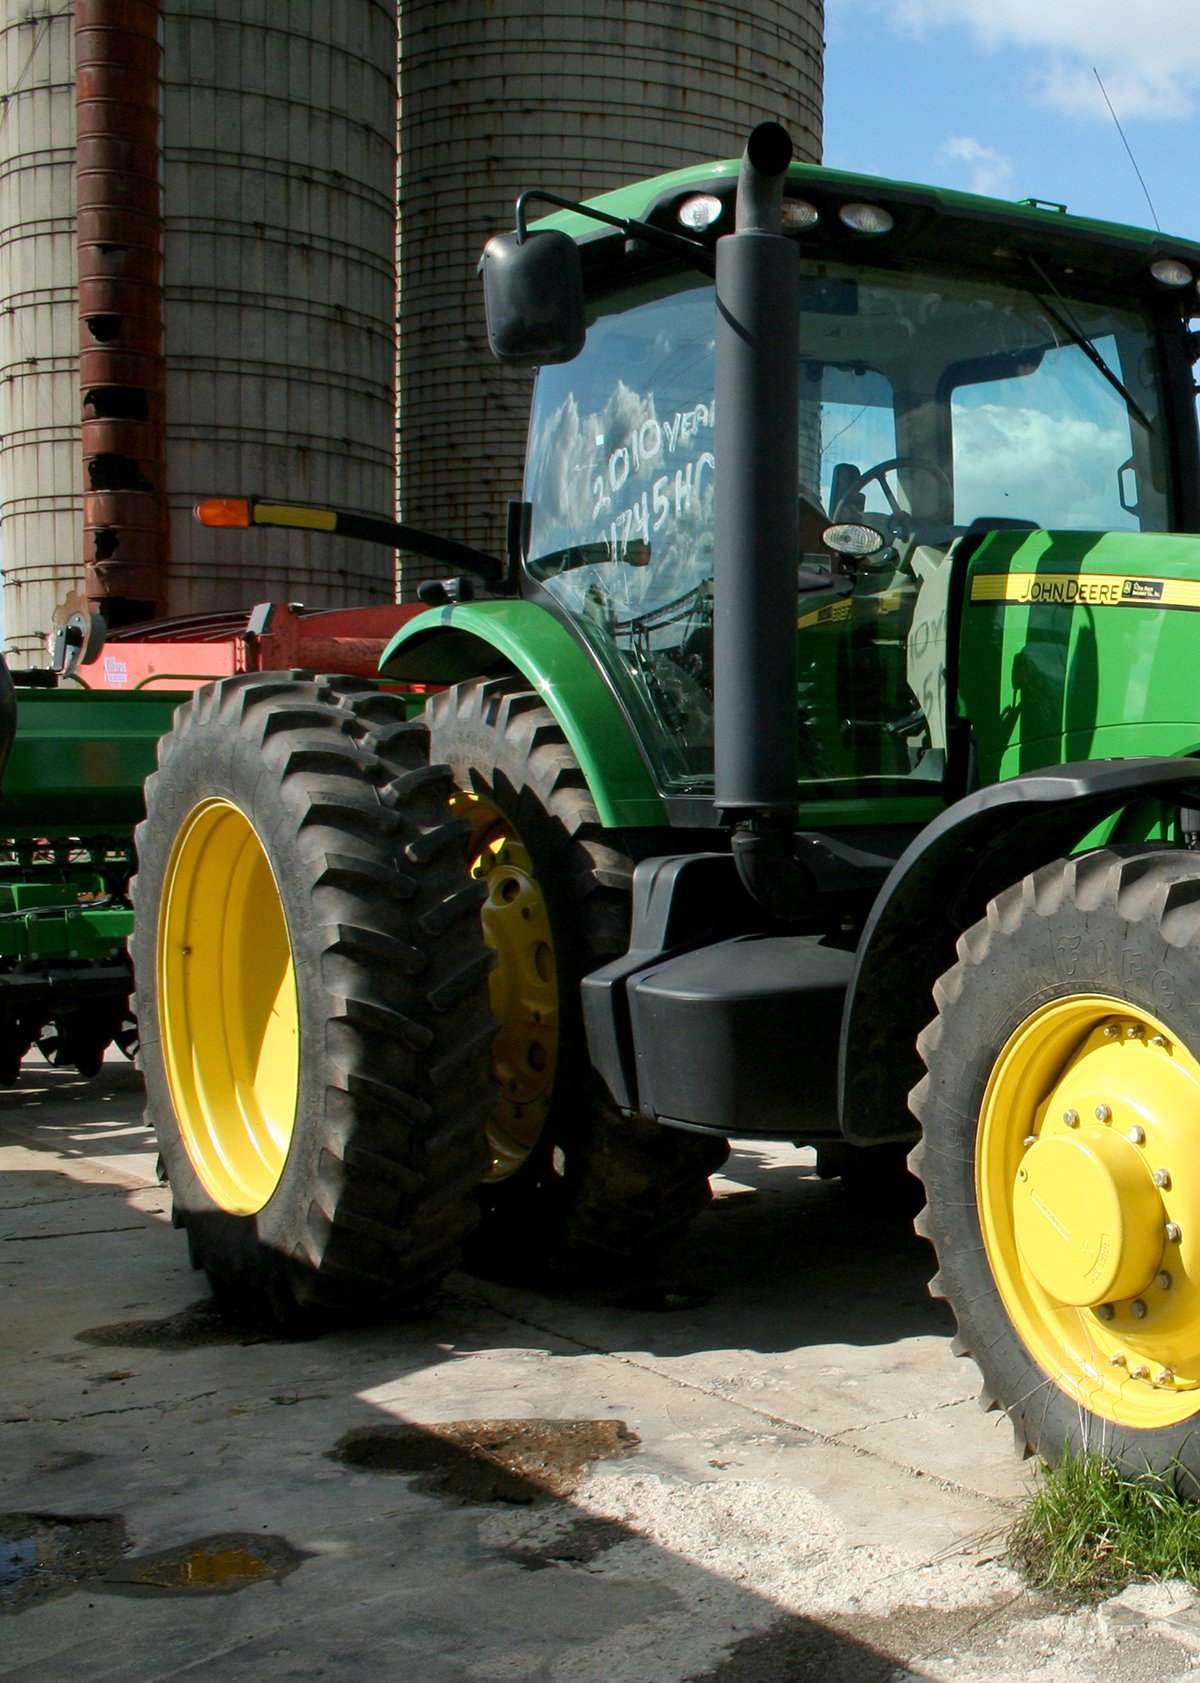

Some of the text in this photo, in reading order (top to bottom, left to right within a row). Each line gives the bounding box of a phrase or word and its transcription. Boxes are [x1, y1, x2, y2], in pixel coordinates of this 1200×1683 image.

[592, 418, 661, 521] 2010
[609, 475, 670, 562] 1745
[1021, 579, 1064, 600] JOHN
[1066, 579, 1120, 602] DEERE
